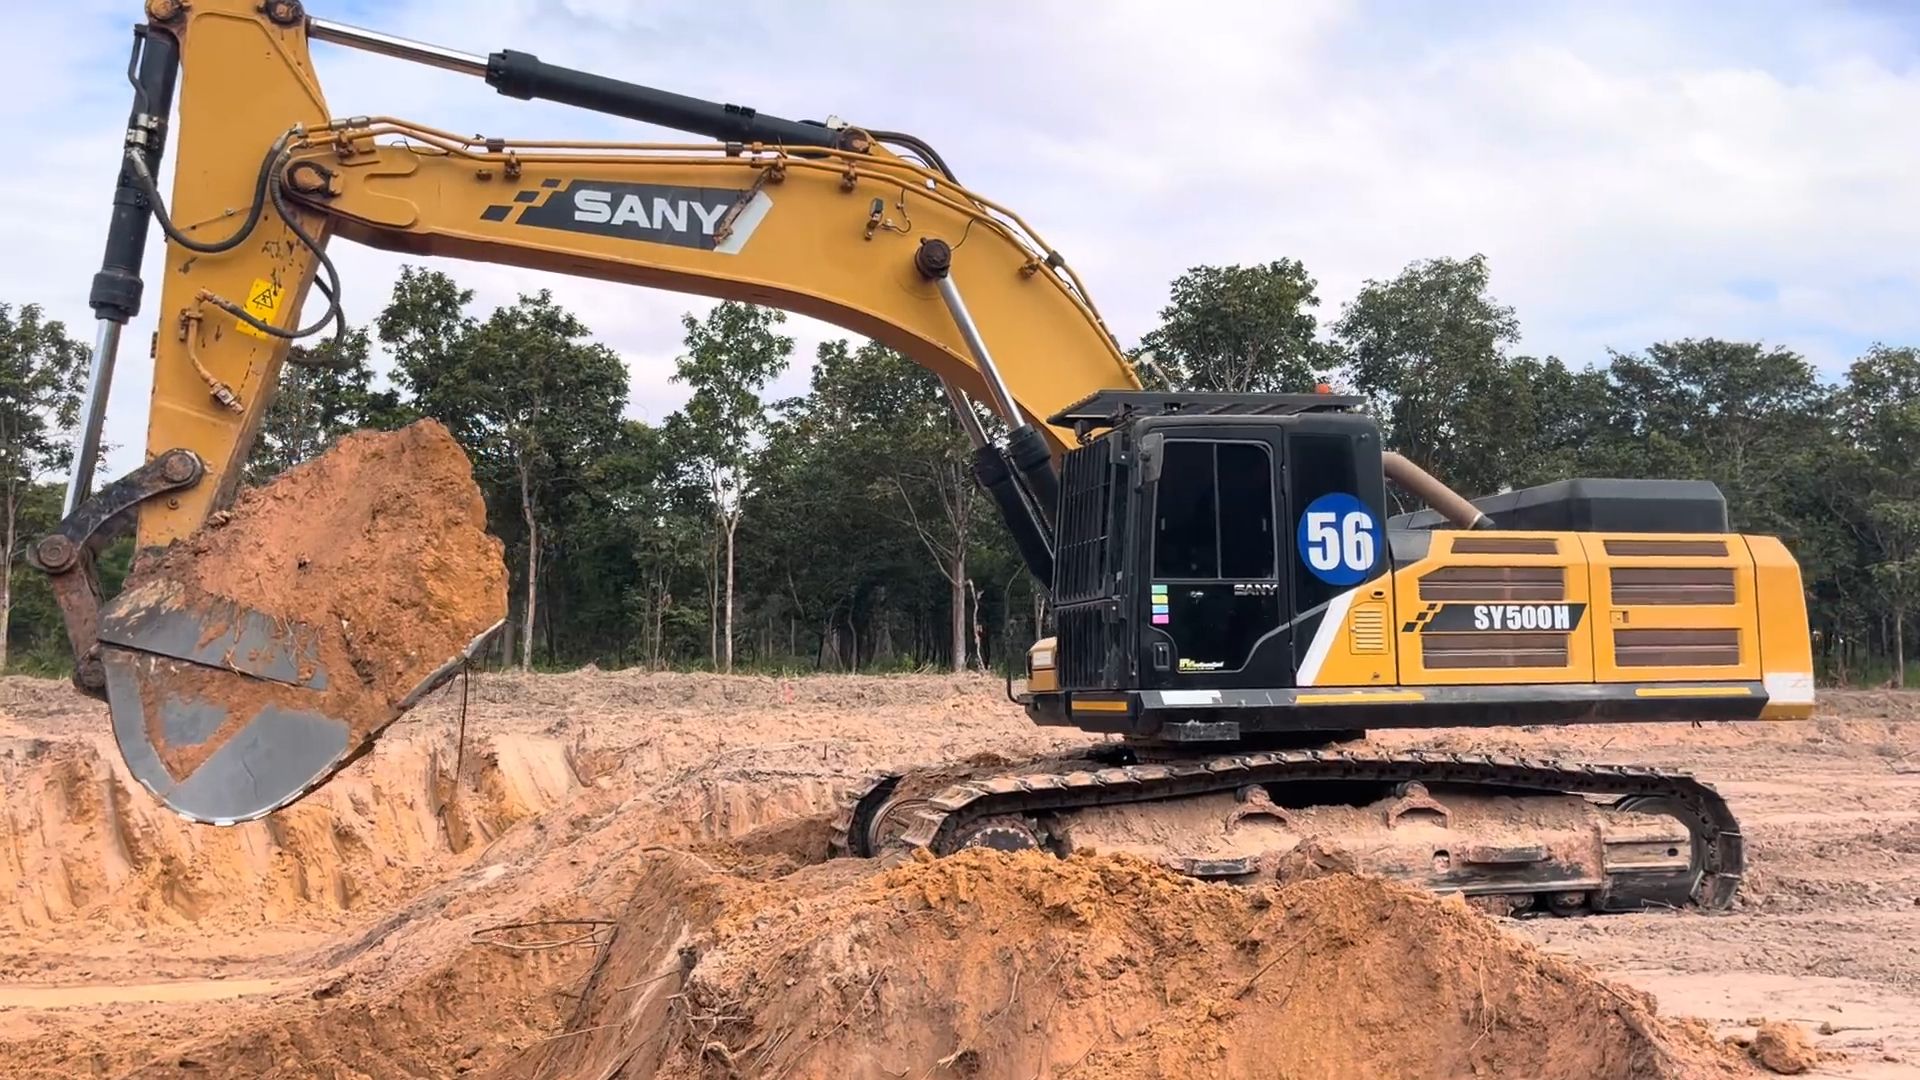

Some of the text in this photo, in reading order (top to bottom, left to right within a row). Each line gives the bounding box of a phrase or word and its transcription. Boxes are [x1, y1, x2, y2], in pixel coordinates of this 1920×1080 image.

[574, 189, 729, 235] SANY
[1307, 511, 1374, 571] 56
[1234, 584, 1278, 596] SANY
[1473, 605, 1570, 631] SY500H
